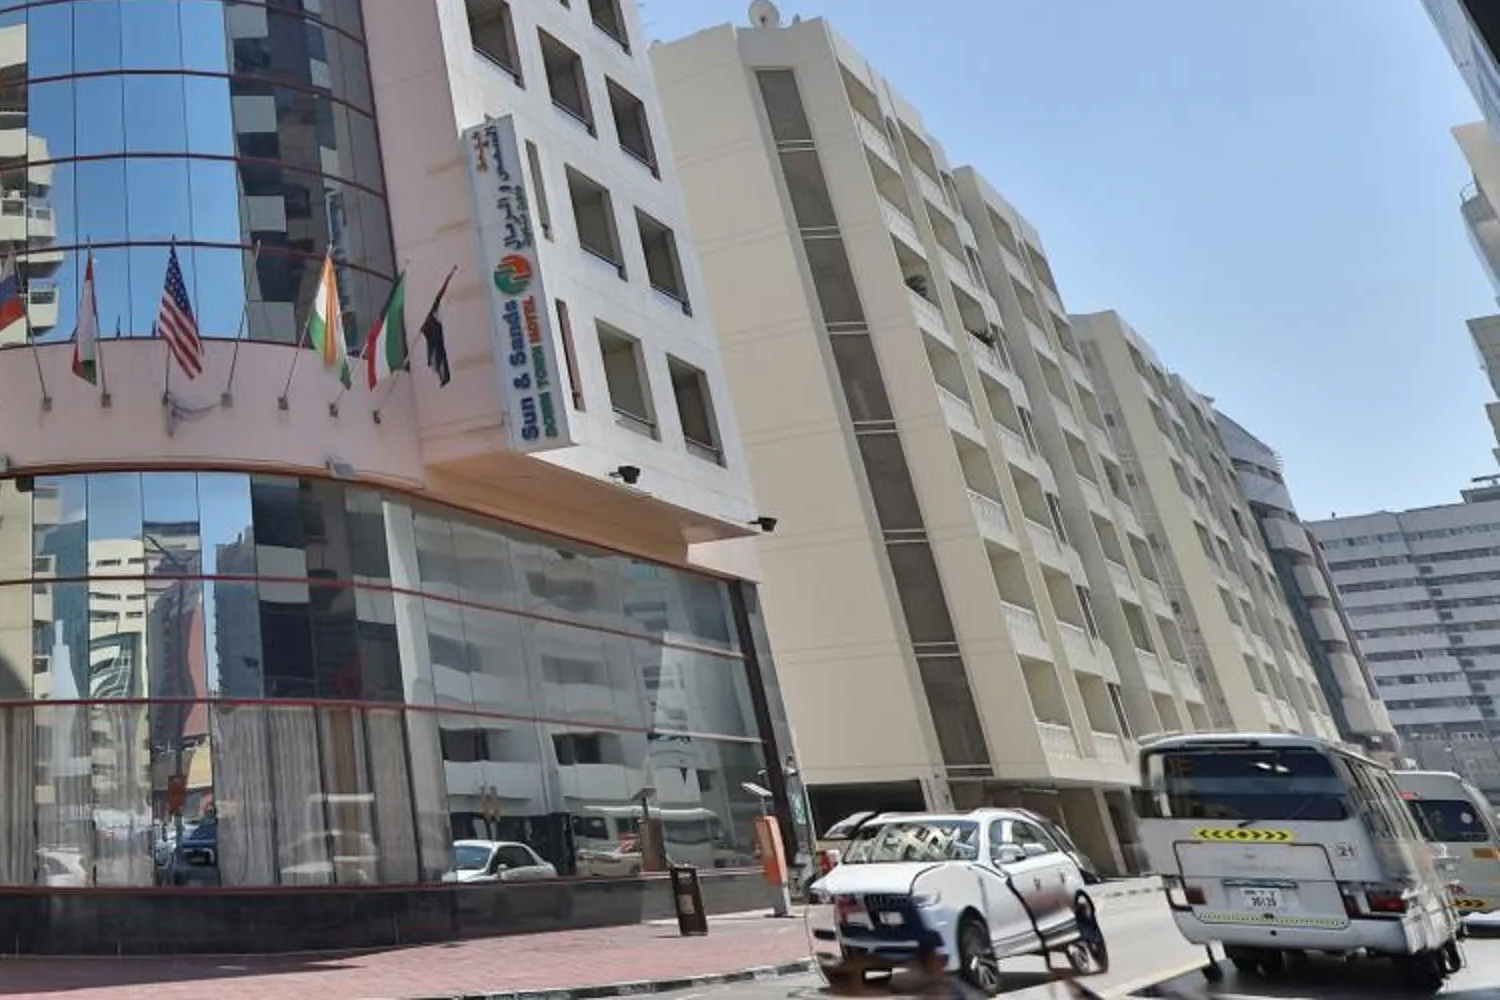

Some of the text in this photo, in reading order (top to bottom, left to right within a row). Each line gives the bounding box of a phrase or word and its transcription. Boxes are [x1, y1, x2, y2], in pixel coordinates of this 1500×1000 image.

[522, 295, 542, 344] HOTEL
[502, 299, 540, 441] Sun & Sands
